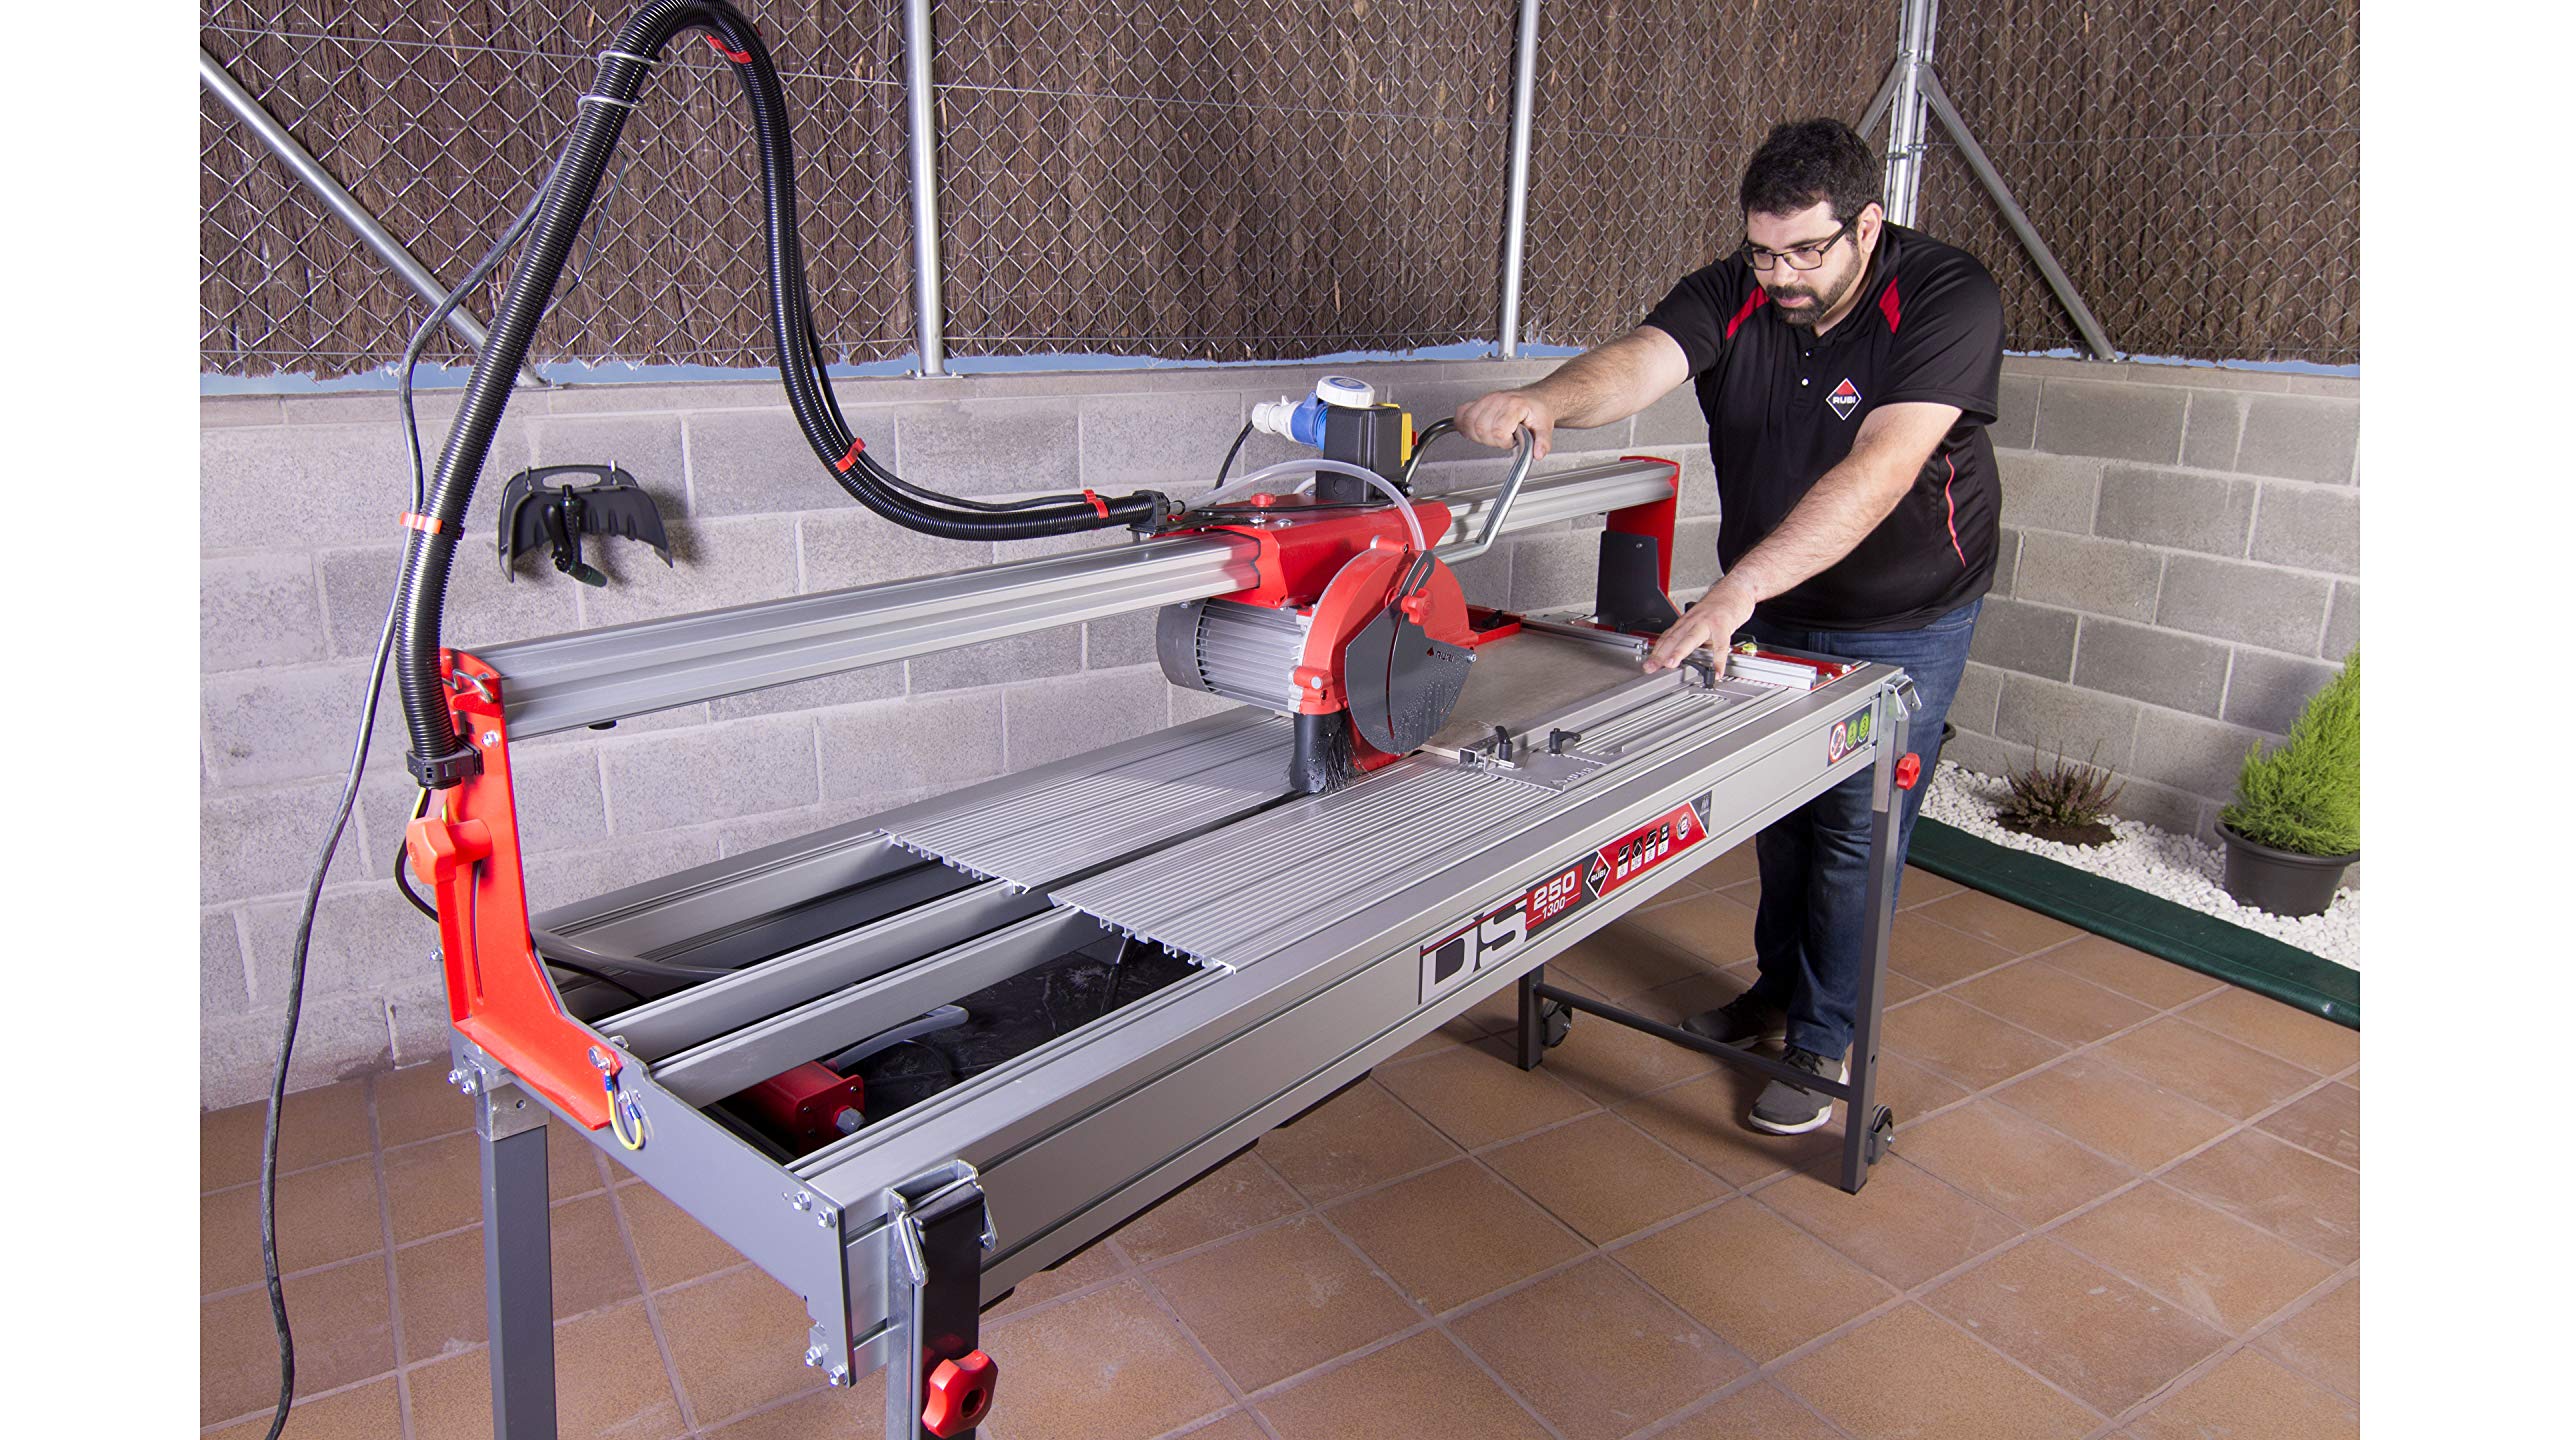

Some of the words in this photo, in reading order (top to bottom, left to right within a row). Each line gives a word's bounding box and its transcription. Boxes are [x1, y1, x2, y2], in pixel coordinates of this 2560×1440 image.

[1832, 396, 1856, 404] RUBI
[1590, 868, 1607, 883] RUBI
[1543, 896, 1566, 919] 1300
[1419, 889, 1528, 1005] DS
[1533, 870, 1576, 911] 250
